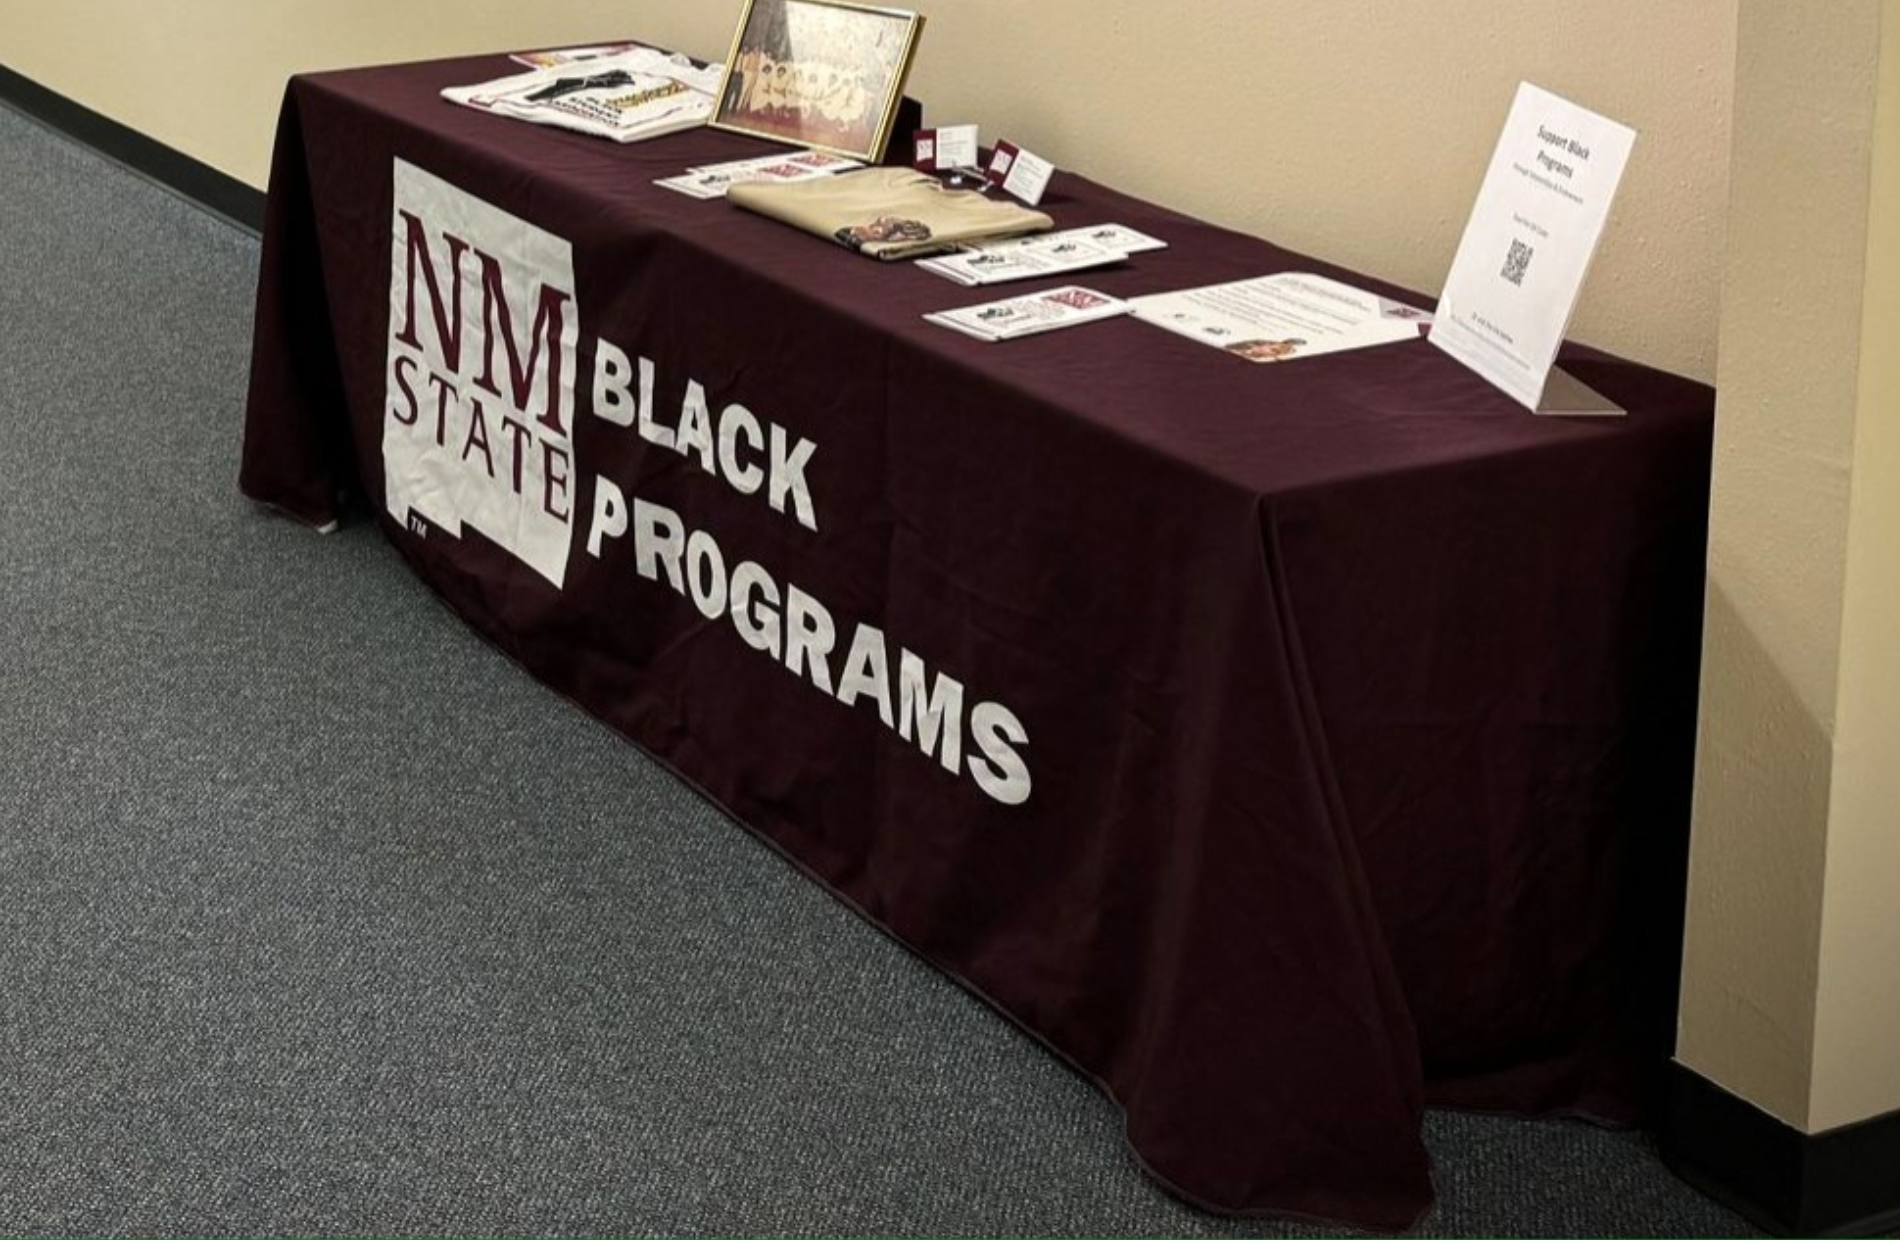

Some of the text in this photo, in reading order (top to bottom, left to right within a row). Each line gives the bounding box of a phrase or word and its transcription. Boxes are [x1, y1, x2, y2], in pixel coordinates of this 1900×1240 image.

[395, 208, 573, 439] NM
[391, 355, 571, 525] STATE
[592, 337, 819, 533] BLACK
[586, 474, 1033, 806] PROGRAMS
